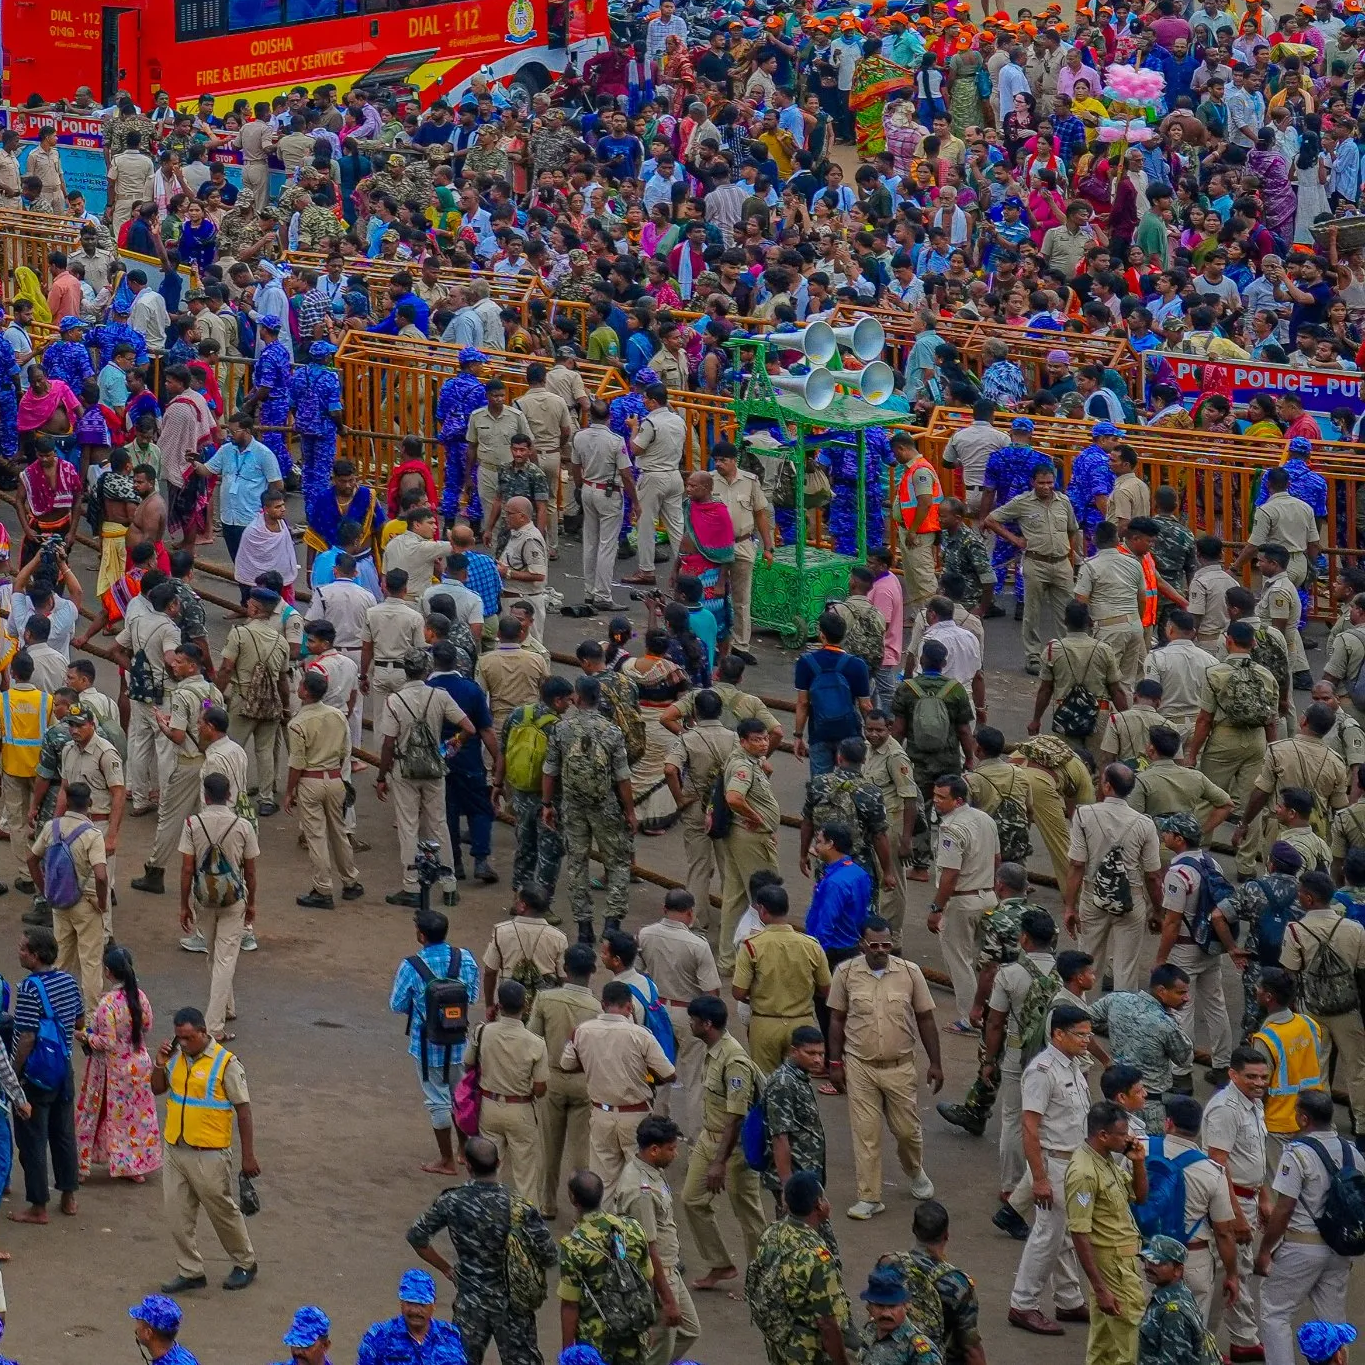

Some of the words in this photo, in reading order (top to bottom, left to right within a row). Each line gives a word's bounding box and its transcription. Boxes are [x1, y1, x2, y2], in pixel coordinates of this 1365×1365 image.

[50, 9, 73, 23] DIAL
[82, 13, 100, 25] 112
[408, 15, 441, 38] DIAL
[454, 8, 479, 32] 112
[514, 15, 527, 26] OFS
[250, 36, 293, 56] ODISHA
[196, 68, 220, 87] FIRE
[222, 66, 231, 83] &
[233, 56, 300, 81] EMERGENCY
[301, 50, 345, 71] SERVICE
[29, 116, 58, 132] PURI
[76, 139, 95, 147] STOP
[215, 154, 234, 164] STOP
[69, 177, 107, 187] AMPERE
[1234, 368, 1320, 397] POLICE,
[1326, 378, 1362, 397] PU
